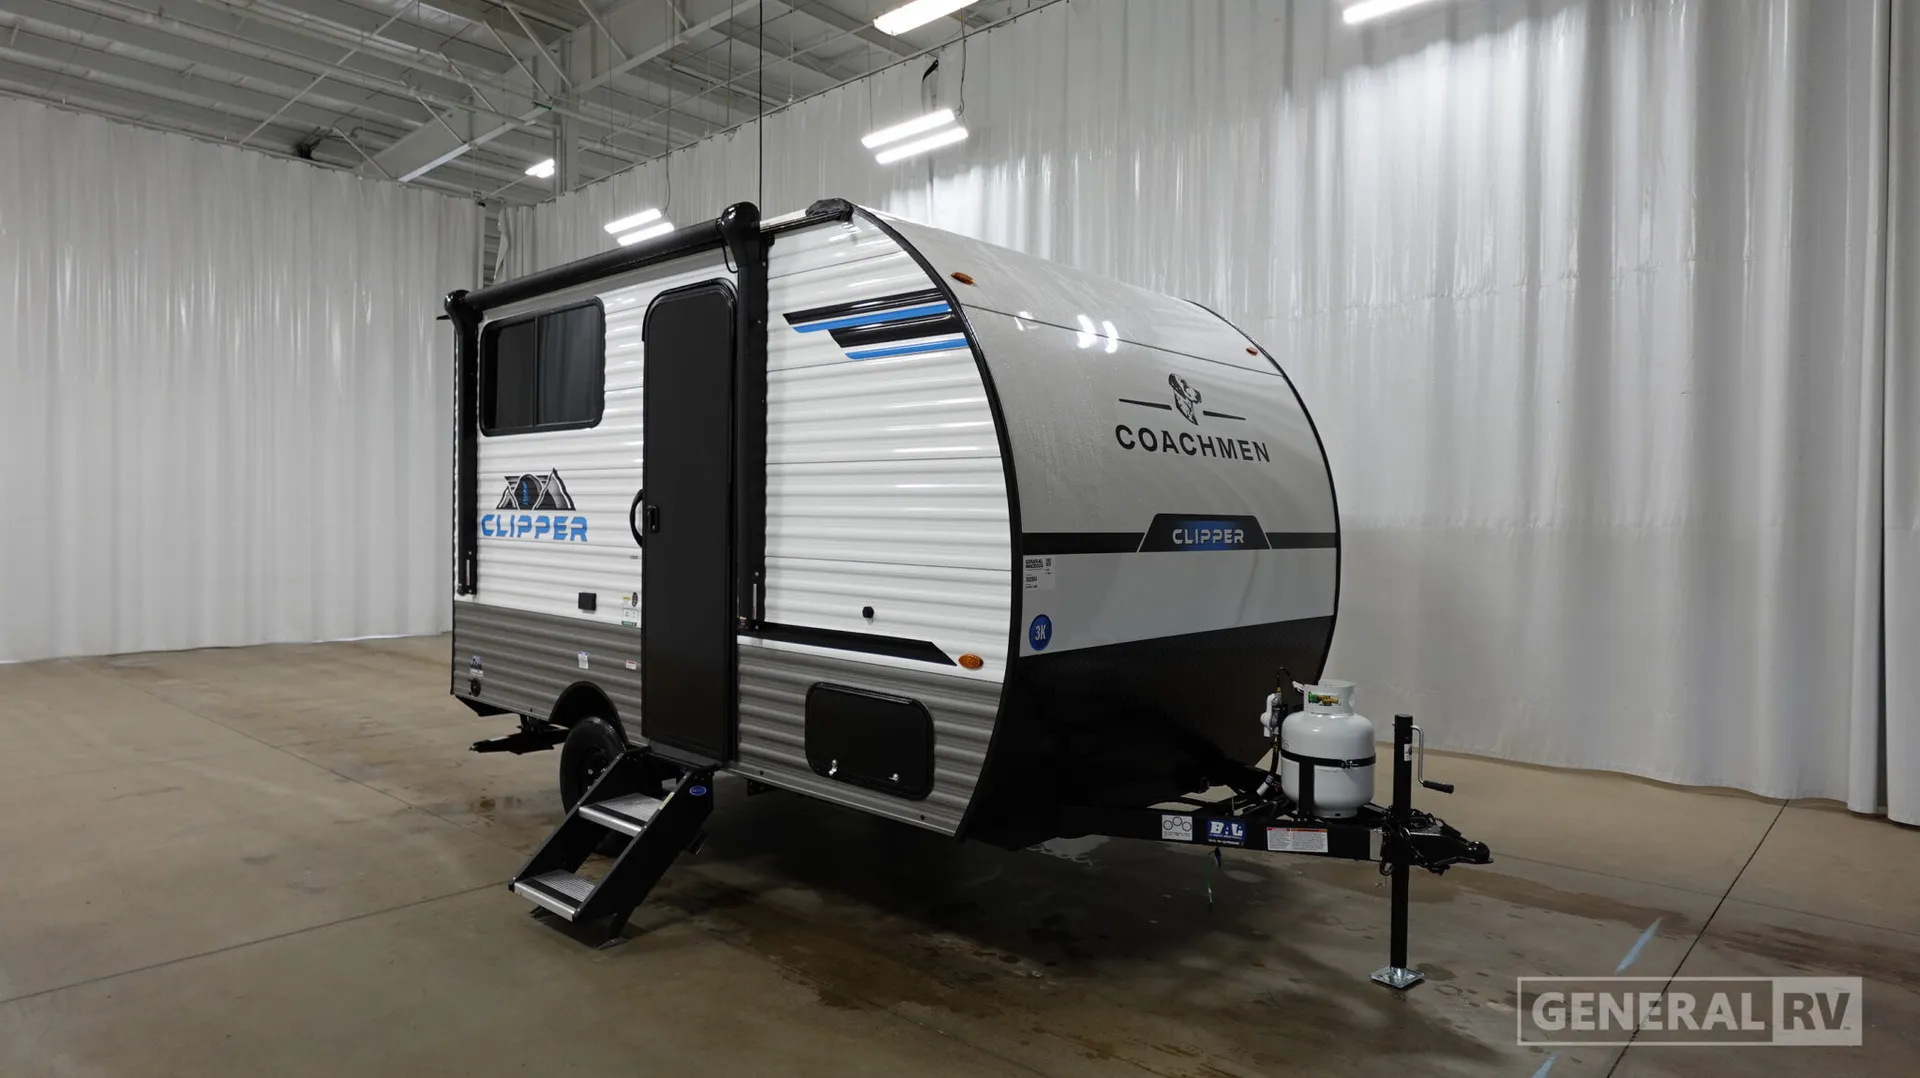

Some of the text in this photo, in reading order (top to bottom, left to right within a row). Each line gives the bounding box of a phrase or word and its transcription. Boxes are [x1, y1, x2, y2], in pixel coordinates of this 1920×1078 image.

[1115, 424, 1271, 463] COACHMEN
[481, 514, 588, 542] CLIPPER
[1172, 529, 1244, 544] CLIPPER
[1035, 624, 1046, 641] 3K
